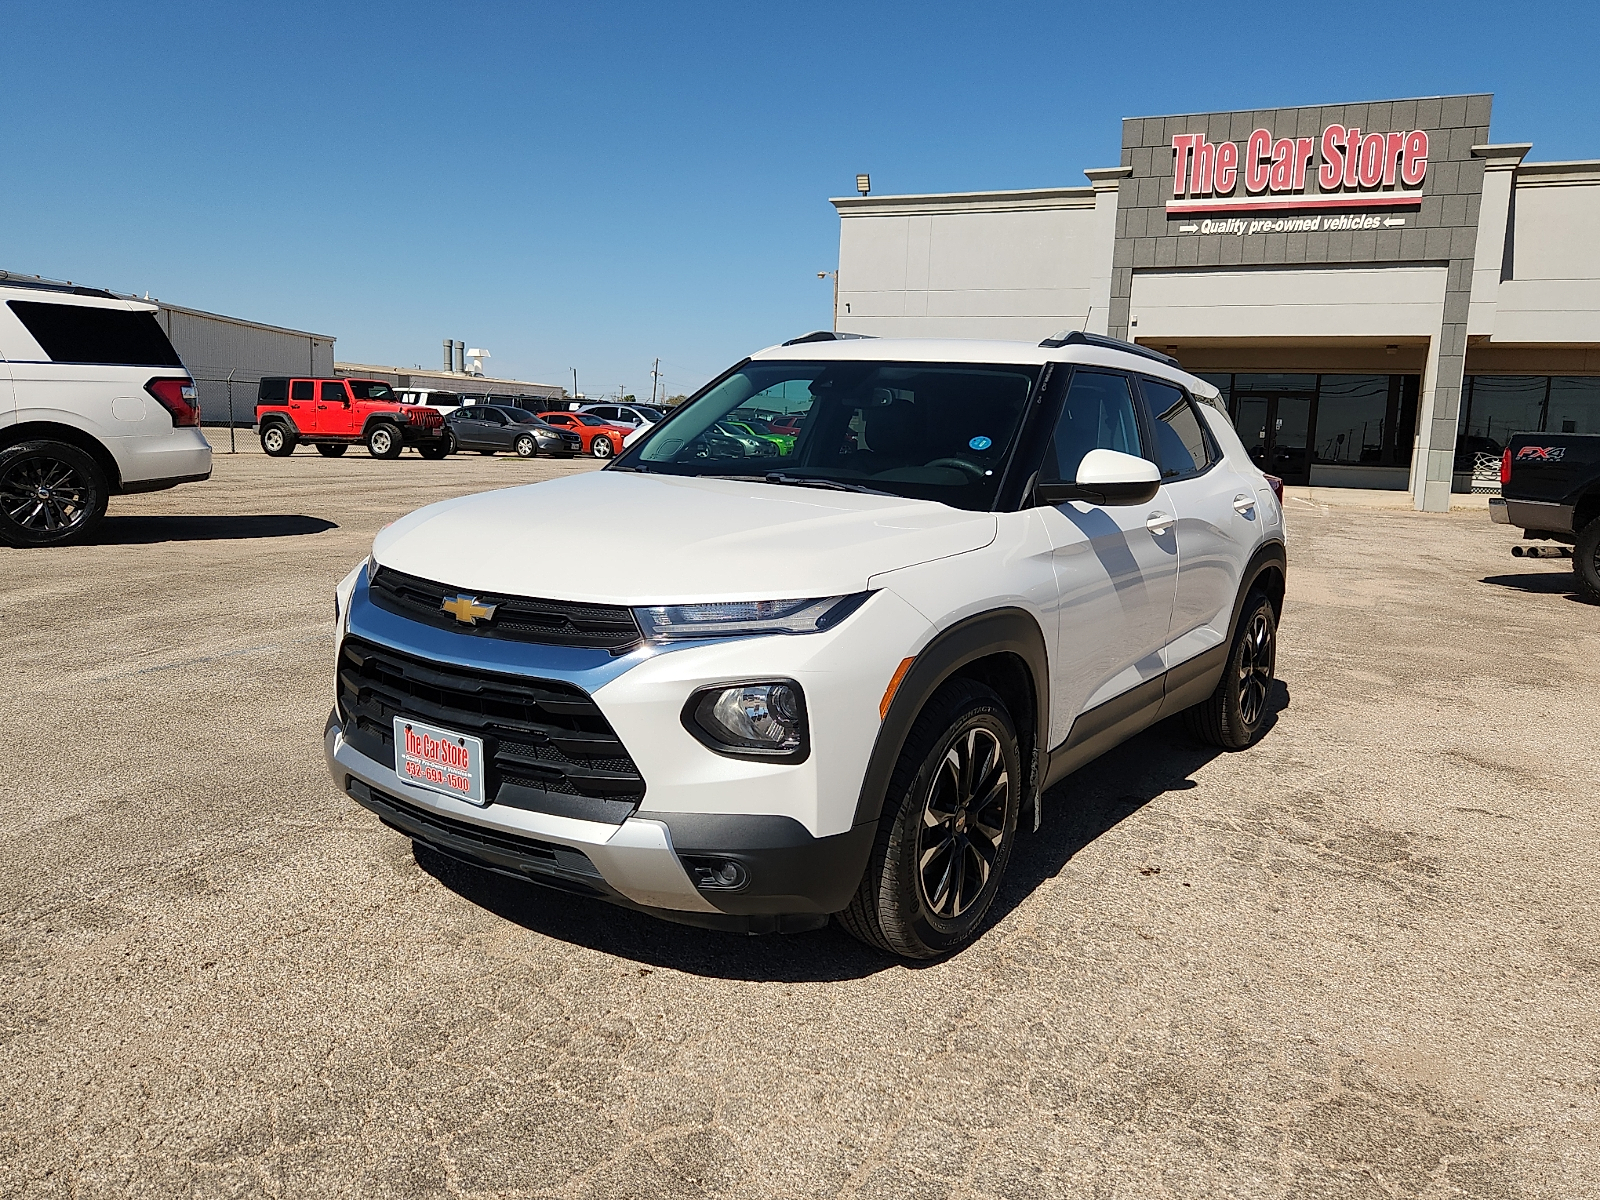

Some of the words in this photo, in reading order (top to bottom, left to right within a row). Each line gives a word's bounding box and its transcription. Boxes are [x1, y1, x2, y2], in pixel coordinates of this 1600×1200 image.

[1172, 132, 1239, 196] The
[1244, 127, 1314, 194] Car
[1318, 123, 1429, 190] Store
[1200, 217, 1247, 236] Quality
[1247, 216, 1322, 236] pre-owned
[1322, 213, 1382, 232] vehicles
[1517, 446, 1566, 459] FX4
[404, 727, 422, 756] The
[423, 733, 440, 760] Car
[441, 738, 469, 769] Store
